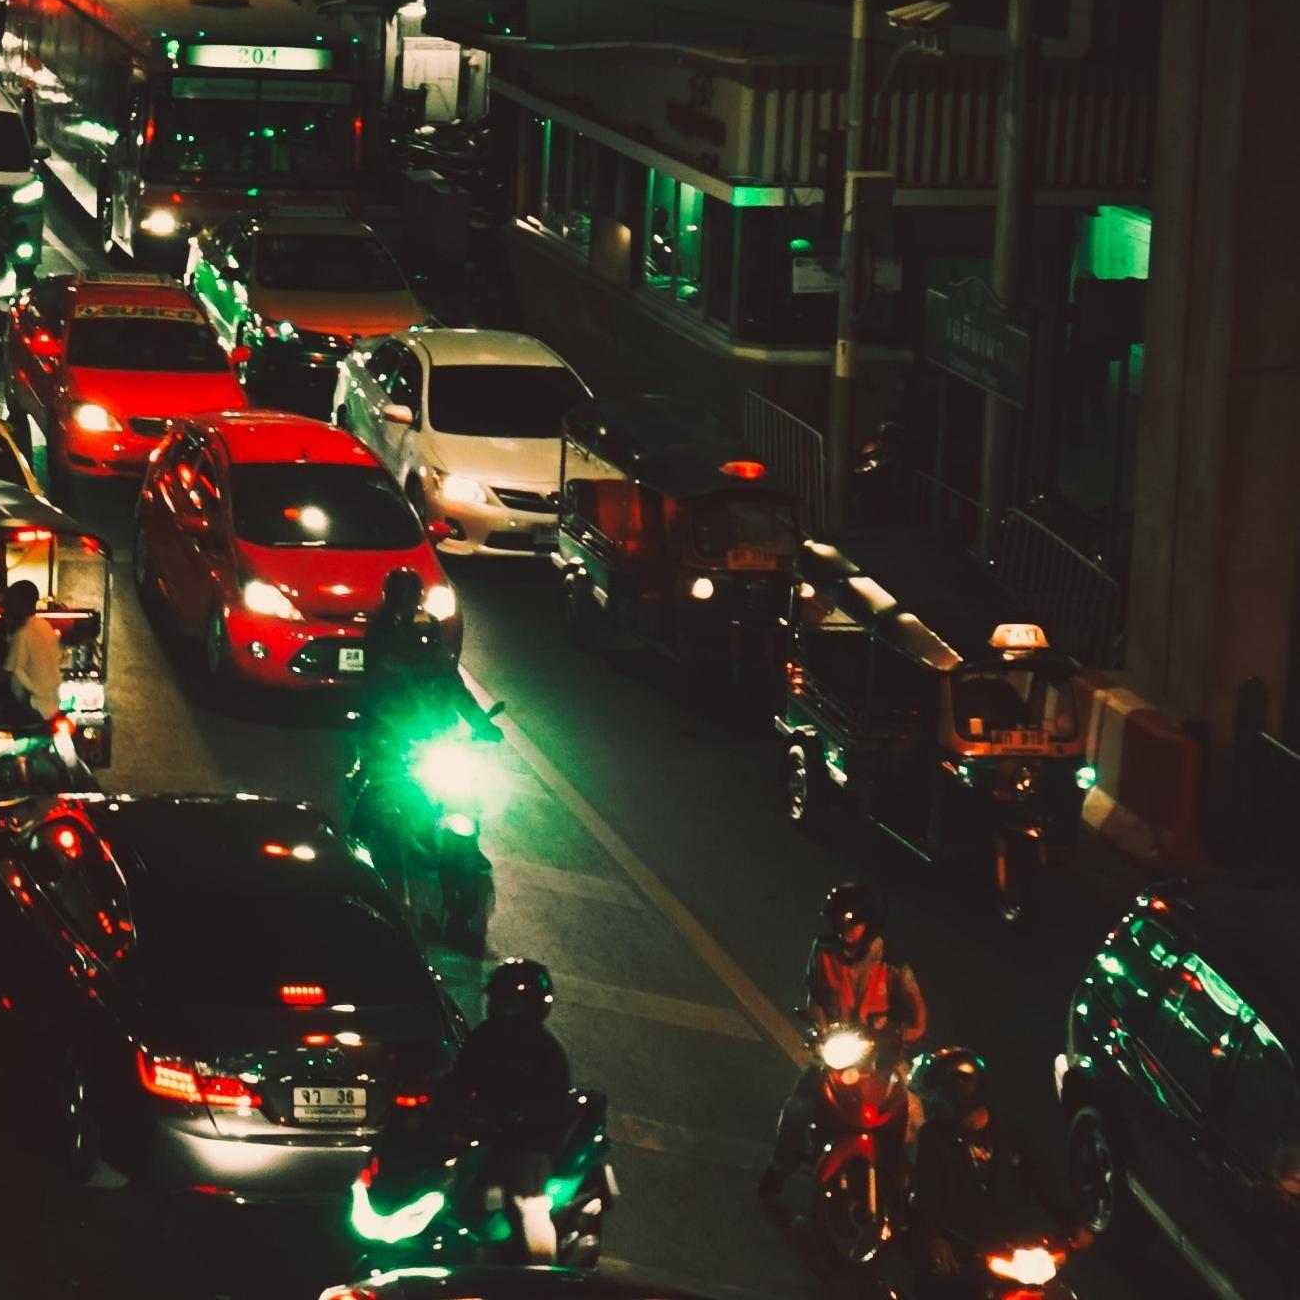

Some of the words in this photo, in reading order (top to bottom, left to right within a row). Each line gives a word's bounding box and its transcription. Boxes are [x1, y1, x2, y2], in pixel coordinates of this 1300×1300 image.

[238, 48, 277, 65] 204
[102, 306, 195, 319] SUSCO
[337, 1089, 355, 1104] 36
